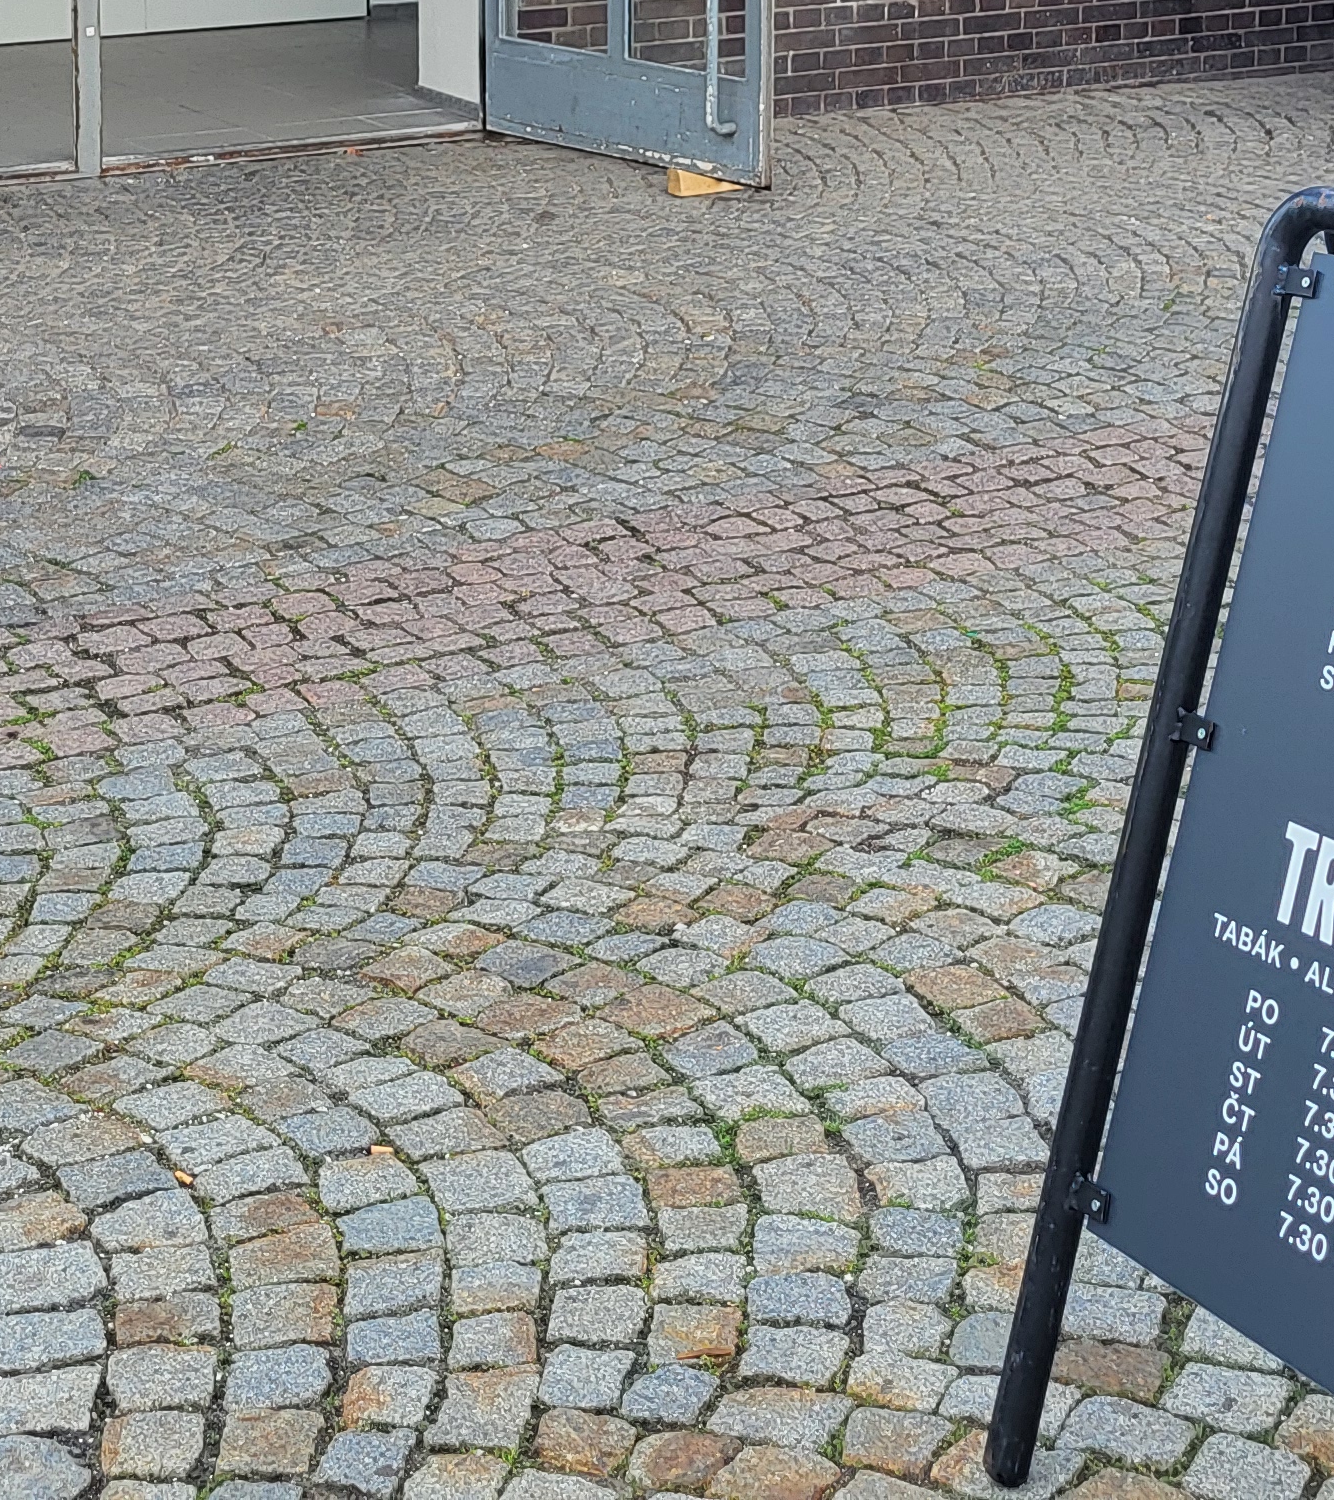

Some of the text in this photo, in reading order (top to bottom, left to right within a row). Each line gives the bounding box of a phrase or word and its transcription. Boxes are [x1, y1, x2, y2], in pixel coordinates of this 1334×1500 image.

[1213, 912, 1285, 969] TABÁK
[1245, 989, 1279, 1025] PO
[1238, 1021, 1271, 1060] ÚT
[1229, 1061, 1262, 1095] ST
[1222, 1090, 1256, 1132] ČT
[1212, 1131, 1243, 1170] PÁ
[1205, 1168, 1237, 1205] SO
[1279, 1210, 1328, 1262] 7.30
